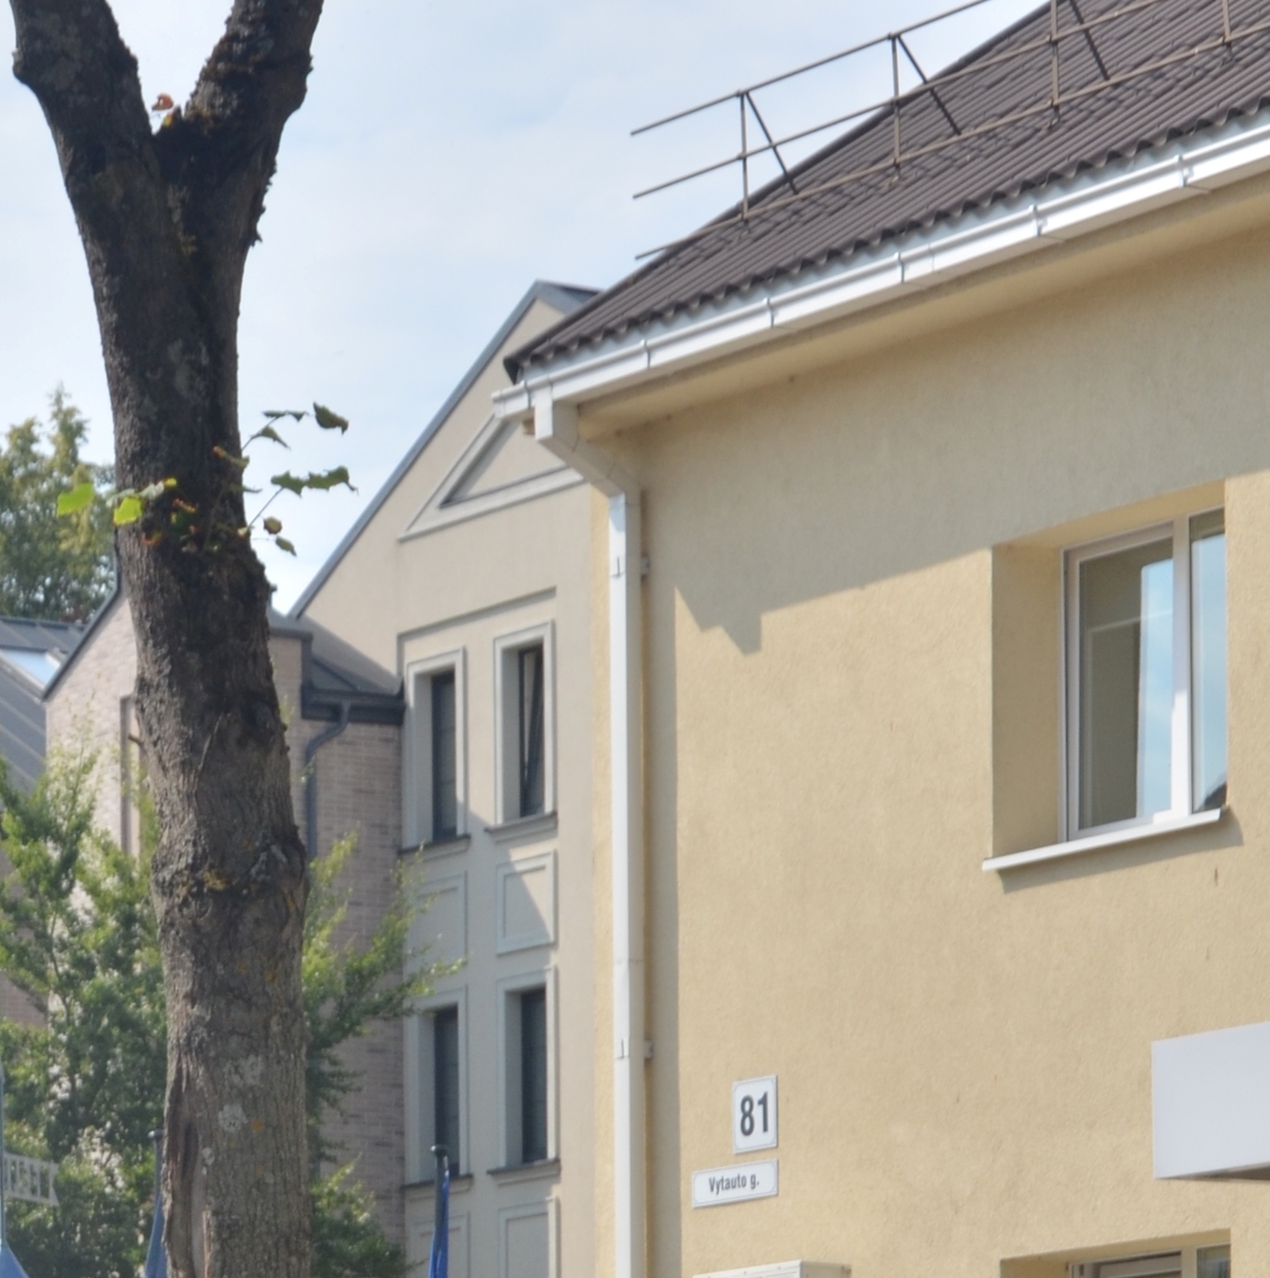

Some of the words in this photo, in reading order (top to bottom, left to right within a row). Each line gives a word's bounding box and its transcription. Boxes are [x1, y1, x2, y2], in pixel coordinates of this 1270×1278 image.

[740, 1091, 768, 1136] 81
[709, 1173, 747, 1195] Vytauto
[750, 1173, 760, 1190] g.
